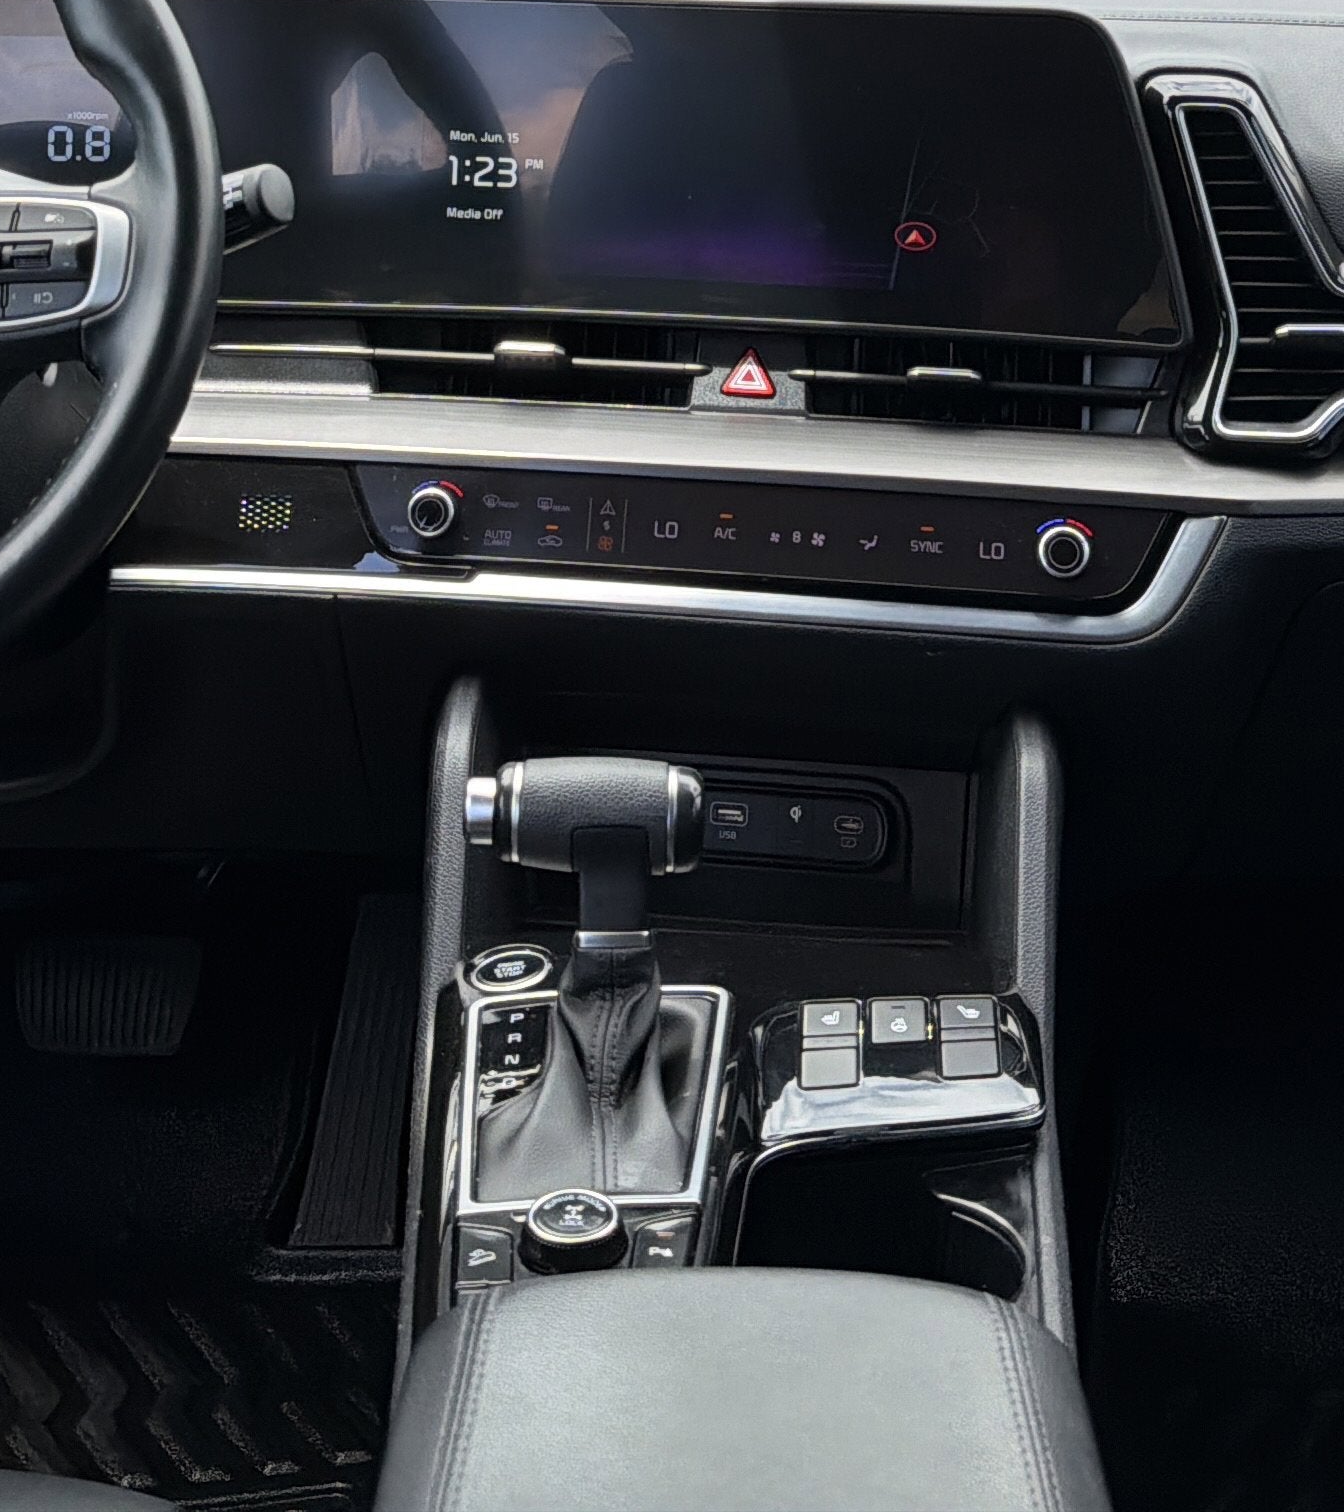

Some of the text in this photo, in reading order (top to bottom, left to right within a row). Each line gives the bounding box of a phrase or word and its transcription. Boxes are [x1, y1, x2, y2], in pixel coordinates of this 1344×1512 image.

[47, 124, 112, 163] 0.8
[507, 132, 521, 144] 15
[448, 155, 544, 188] 1:23 PM
[446, 206, 504, 220] Media Off
[484, 529, 512, 540] AUTO
[653, 520, 679, 539] LO
[713, 526, 737, 541] A/C
[909, 539, 944, 555] SYNC
[979, 541, 1005, 561] LO
[718, 830, 738, 841] USB
[509, 1012, 525, 1024] P
[507, 1032, 523, 1044] R
[504, 1053, 521, 1066] N
